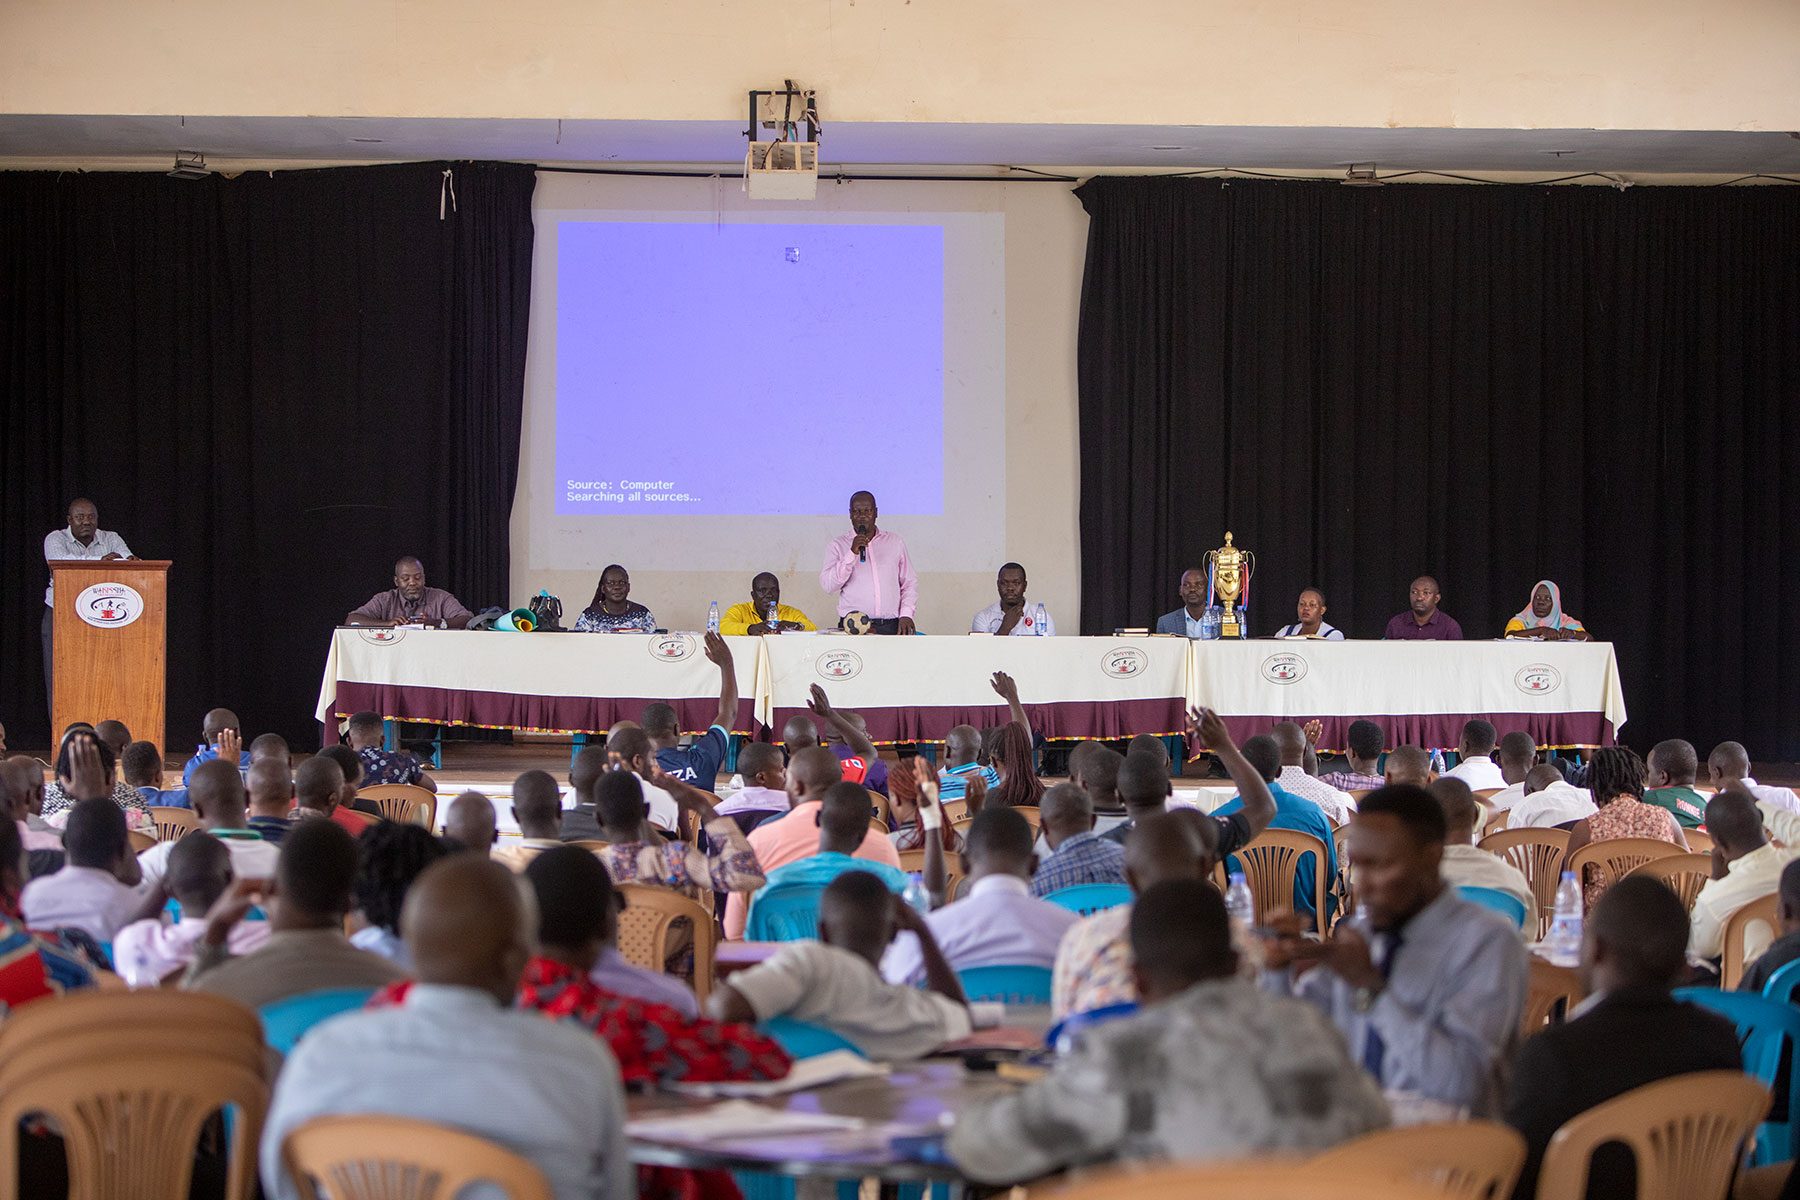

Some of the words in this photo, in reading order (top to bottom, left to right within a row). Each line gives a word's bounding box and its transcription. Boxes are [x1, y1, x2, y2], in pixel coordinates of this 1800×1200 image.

[567, 480, 613, 490] Source:
[620, 480, 675, 491] Computer
[567, 492, 624, 503] Searching
[628, 492, 641, 502] all
[645, 492, 702, 502] sources...
